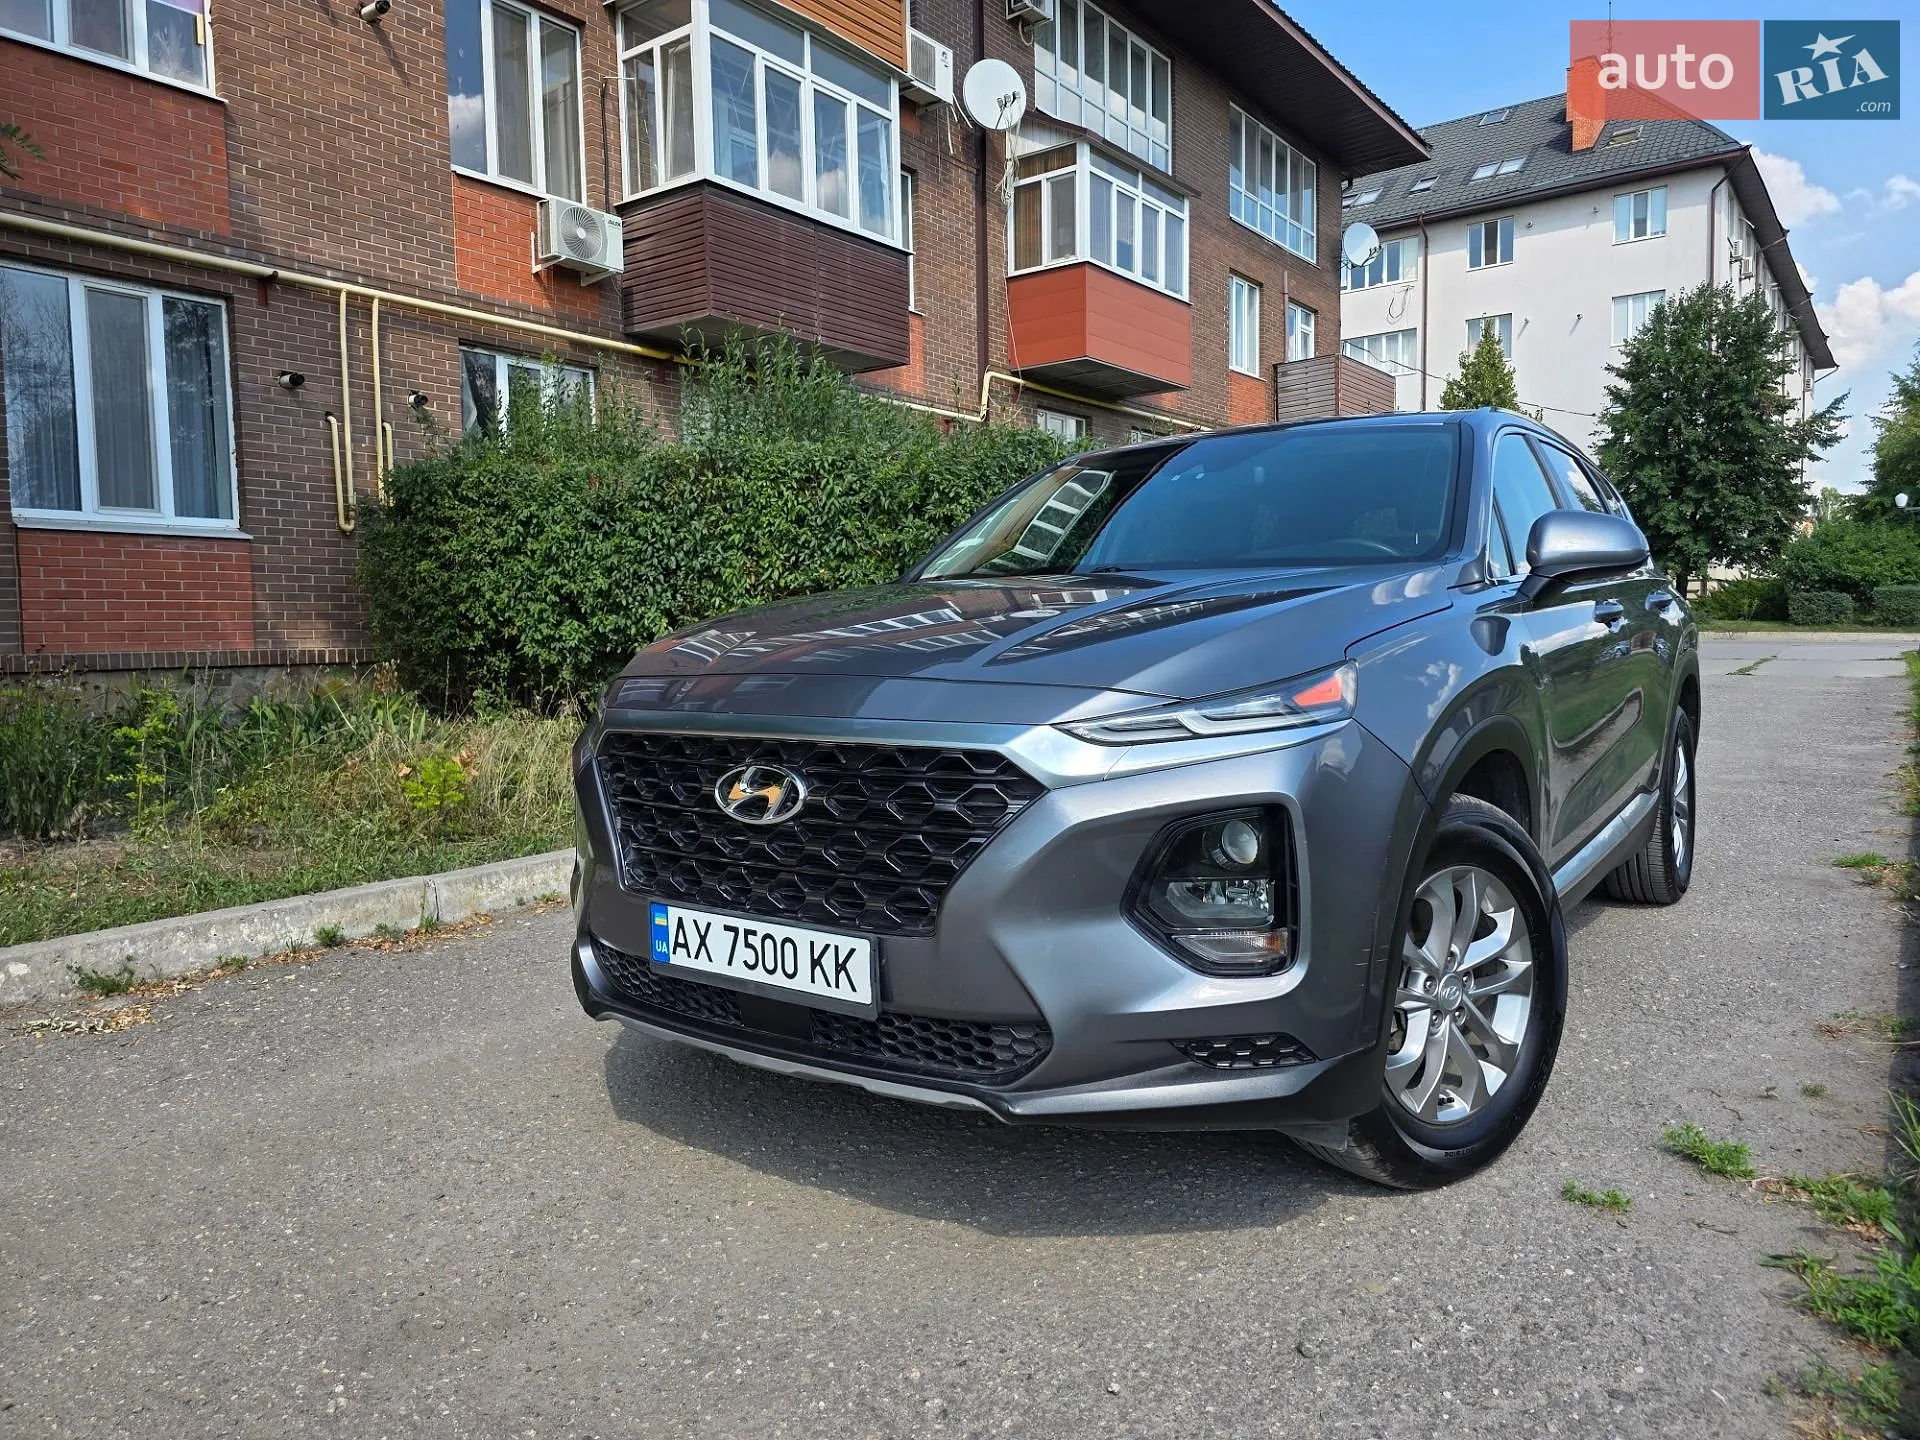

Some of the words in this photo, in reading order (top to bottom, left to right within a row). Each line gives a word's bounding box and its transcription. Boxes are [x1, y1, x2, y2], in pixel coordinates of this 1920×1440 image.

[656, 940, 668, 954] UA
[672, 916, 713, 963] AX
[723, 924, 799, 980] 7500
[809, 940, 858, 993] KK
